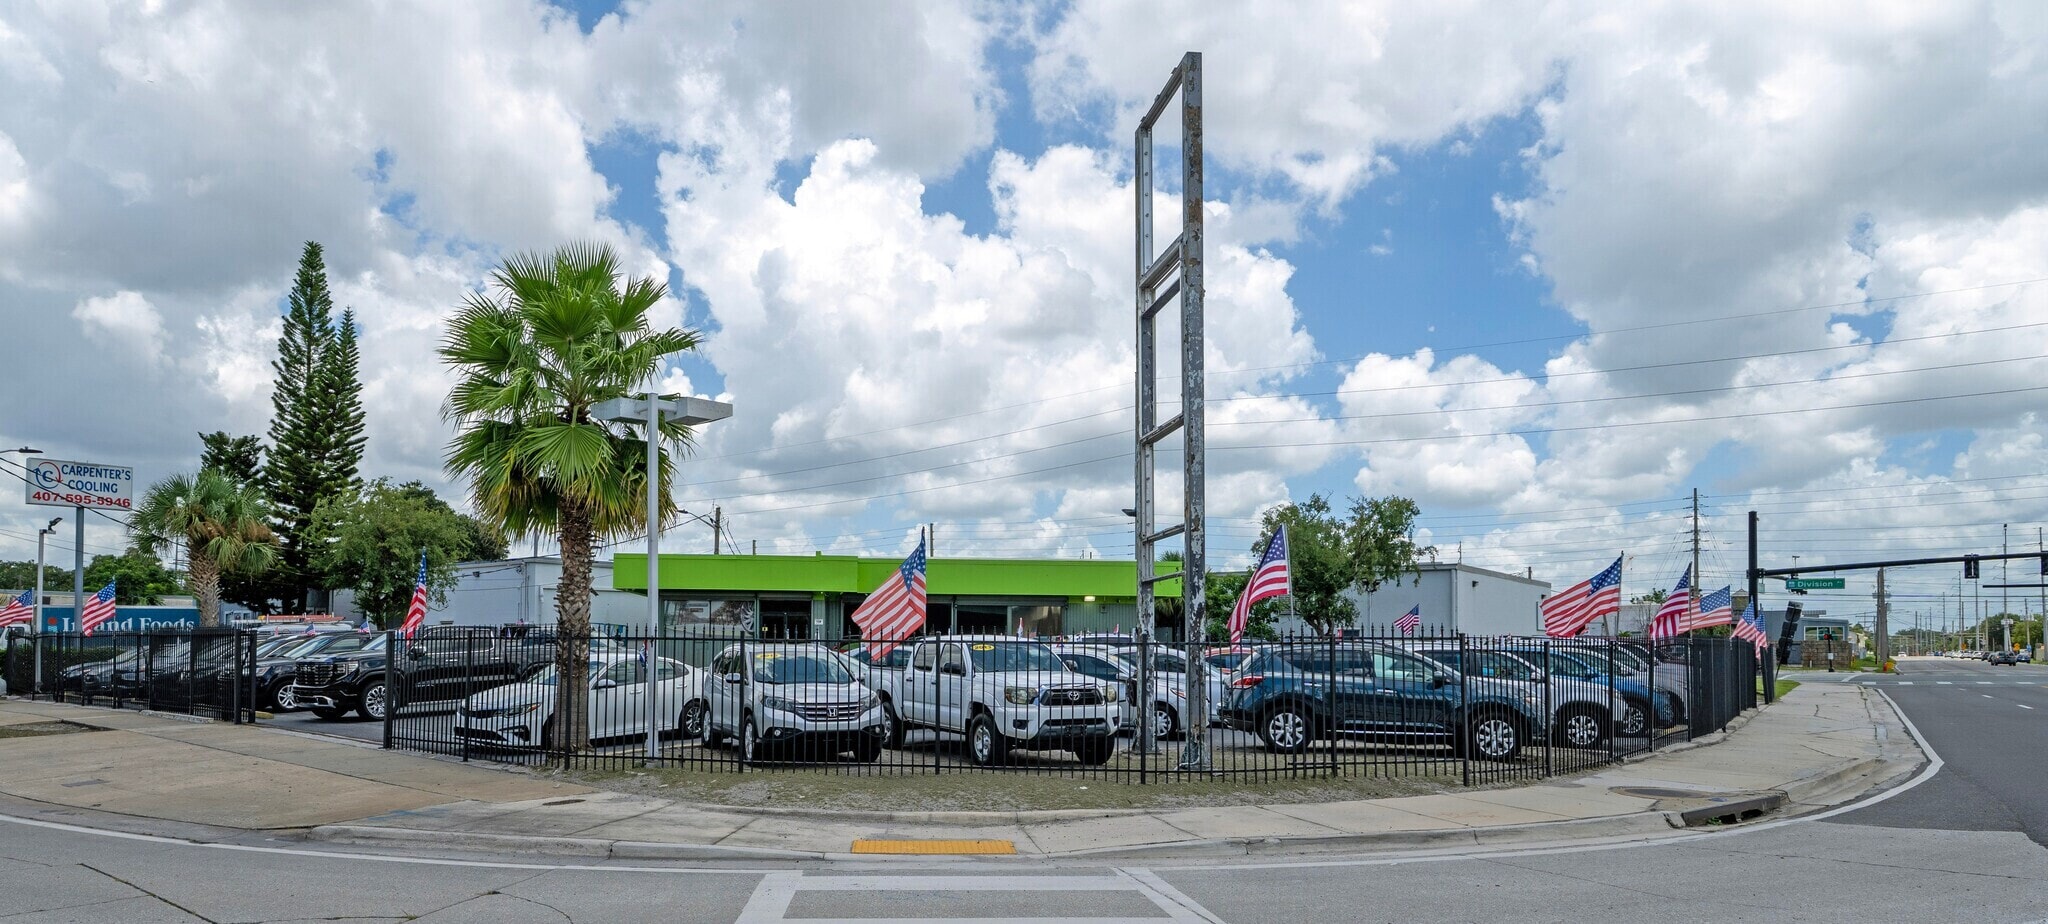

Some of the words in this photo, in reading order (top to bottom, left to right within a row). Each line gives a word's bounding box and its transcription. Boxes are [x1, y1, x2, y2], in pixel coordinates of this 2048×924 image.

[61, 464, 131, 481] CARPENTER'S
[68, 479, 118, 494] COOLING
[32, 491, 131, 508] 407-595-5946
[138, 617, 195, 631] Foods
